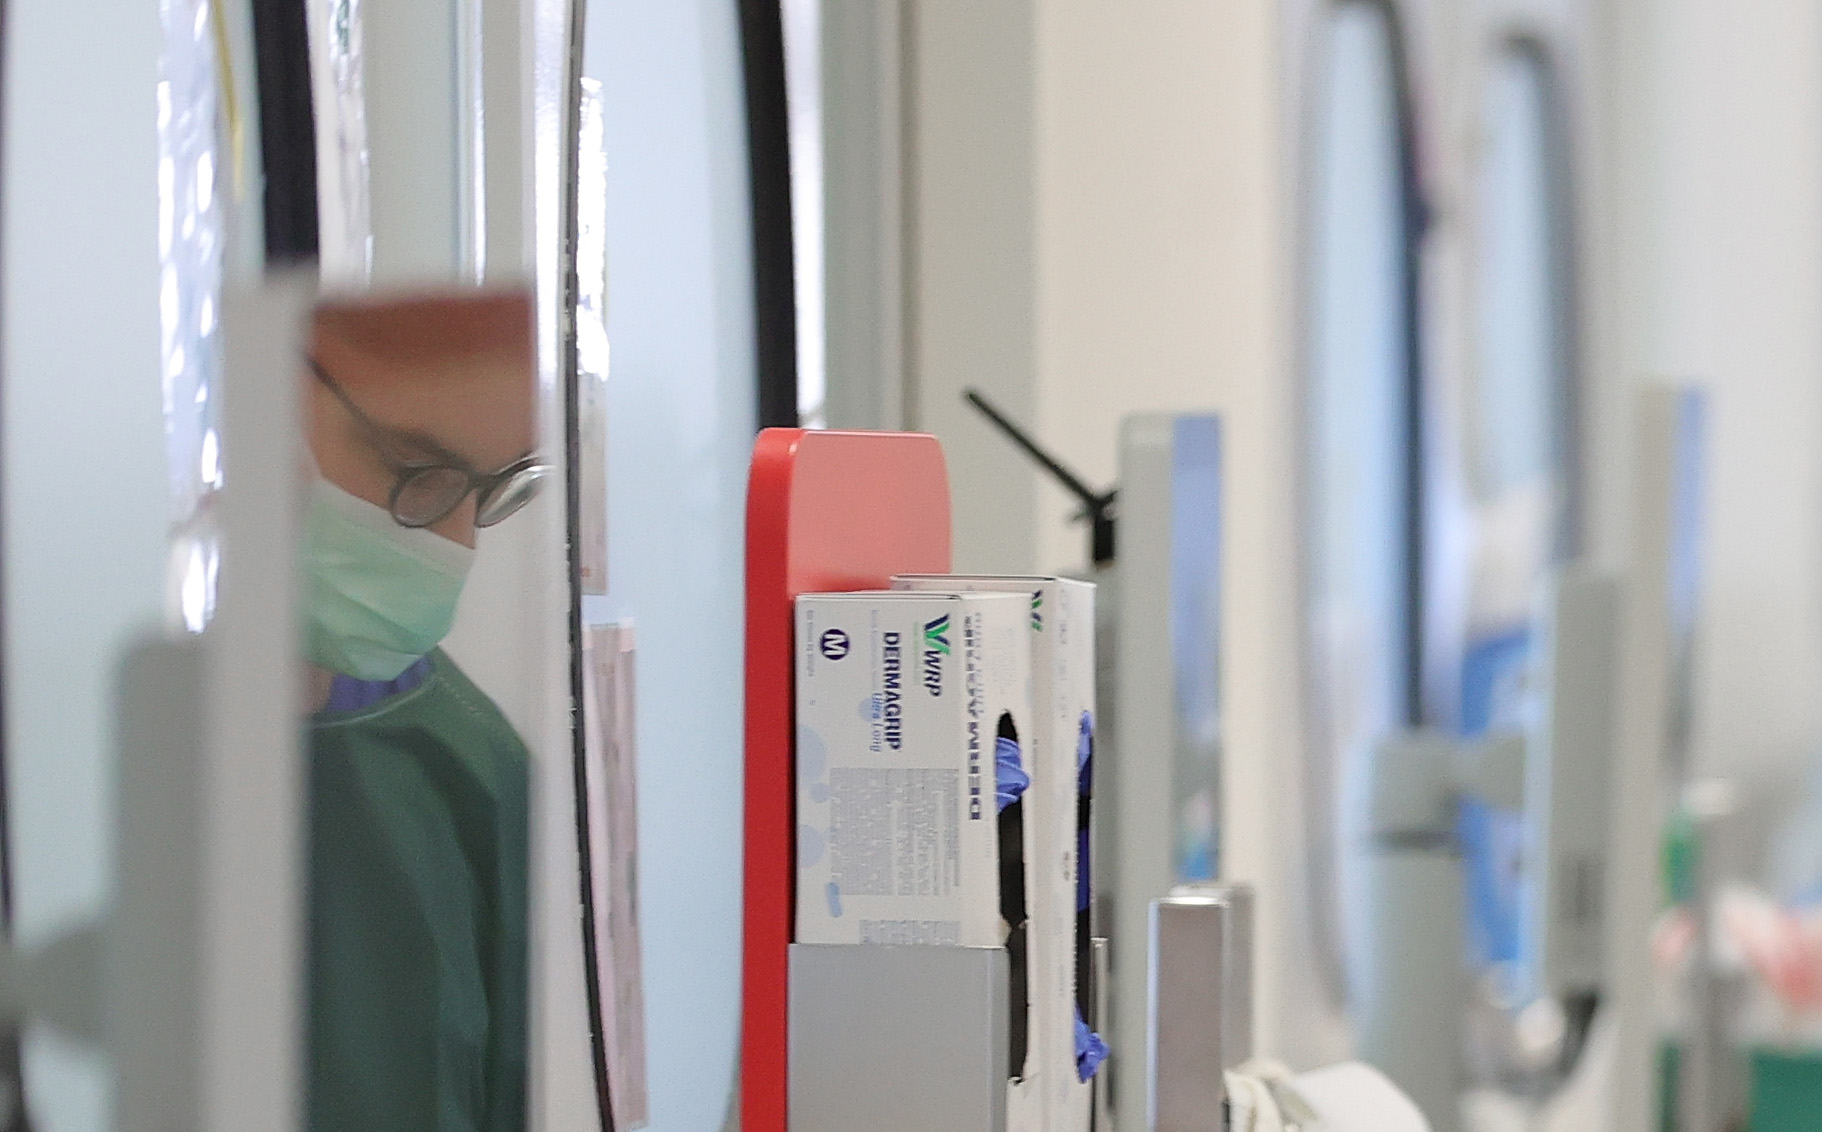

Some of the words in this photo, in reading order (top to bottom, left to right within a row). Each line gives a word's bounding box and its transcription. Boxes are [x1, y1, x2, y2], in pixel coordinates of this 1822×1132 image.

[822, 631, 848, 659] M
[883, 631, 902, 751] DERMAGRIP
[923, 650, 942, 697] WRP
